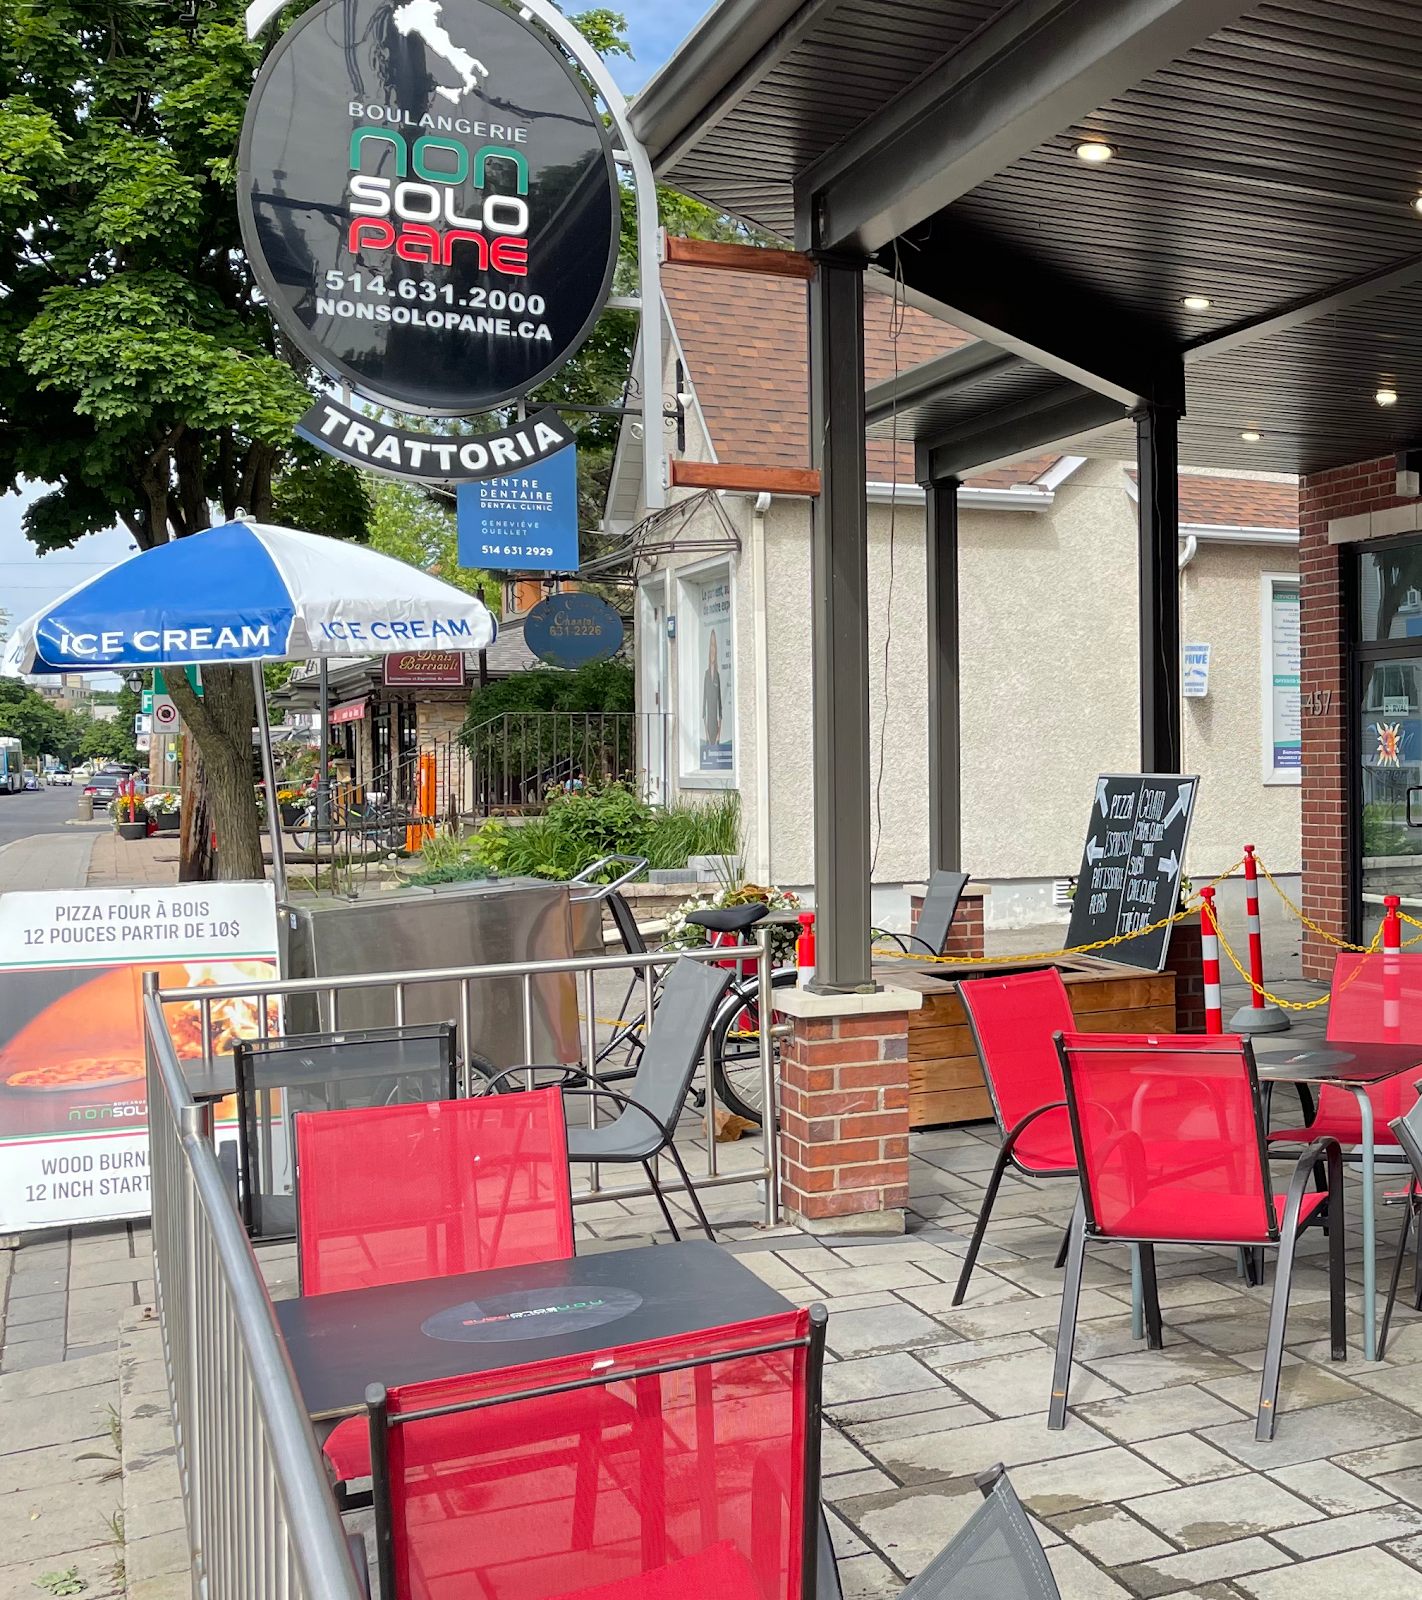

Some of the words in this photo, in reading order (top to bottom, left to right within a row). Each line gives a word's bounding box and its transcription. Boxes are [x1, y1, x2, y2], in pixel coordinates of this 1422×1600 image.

[348, 101, 528, 143] BOULANGERIE
[349, 175, 529, 234] SOLO
[325, 270, 545, 315] 514.631.2000
[316, 299, 552, 341] NONSOLOPANE.CA
[319, 405, 564, 471] TRATTORIA
[480, 489, 553, 501] DENTAIRE
[481, 502, 517, 510] DENTAL
[520, 503, 553, 512] CLINIC
[481, 528, 527, 536] OUELLET
[482, 545, 500, 554] 514
[503, 546, 522, 555] 631
[525, 547, 553, 556] 2929
[554, 611, 595, 626] Chantal
[60, 631, 124, 654] ICE
[133, 625, 270, 652] CREAM
[320, 621, 368, 641] ICE
[370, 619, 473, 641] CREAM
[549, 625, 601, 637] 631-2226
[399, 655, 459, 671] Barriault
[416, 650, 452, 661] Denis
[1185, 652, 1208, 665] PRIVÉ
[1301, 690, 1331, 716] 457
[1110, 792, 1134, 819] PIZZA
[55, 905, 103, 922] PIZZA
[108, 904, 151, 920] FOUR
[156, 899, 168, 919] À
[172, 901, 210, 918] BOIS
[24, 928, 45, 945] 12
[50, 926, 117, 944] POUCES
[121, 924, 179, 941] PARTIR
[184, 922, 205, 939] DE
[209, 919, 240, 939] 10$
[42, 1155, 93, 1176] WOOD
[26, 1183, 47, 1202] 12
[53, 1179, 93, 1200] INCH
